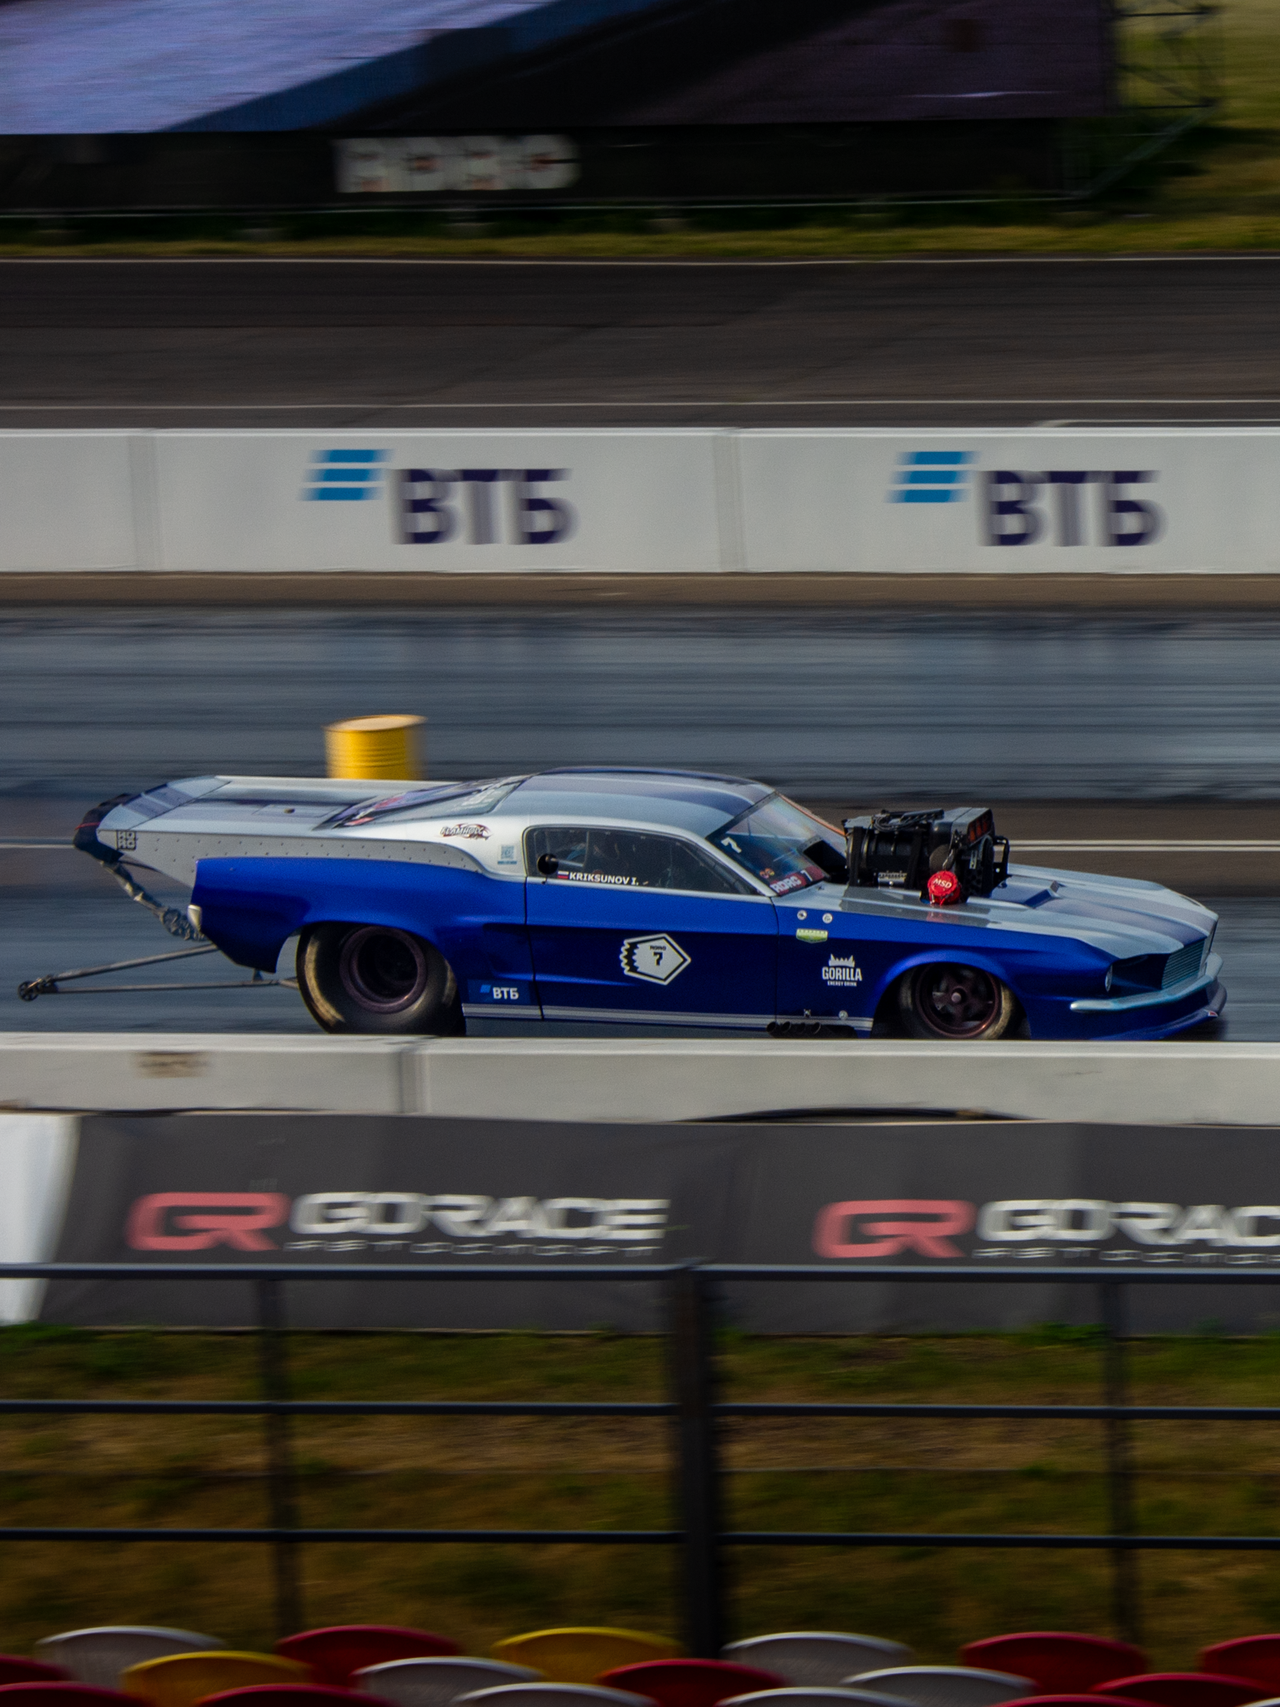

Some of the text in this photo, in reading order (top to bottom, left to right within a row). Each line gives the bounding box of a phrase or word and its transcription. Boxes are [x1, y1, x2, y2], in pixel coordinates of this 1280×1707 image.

[391, 468, 579, 545] ВТБ
[977, 470, 1167, 547] ВТБ
[720, 836, 742, 854] 7
[569, 871, 630, 885] KRIKSUNOV
[932, 878, 953, 888] MSD
[653, 952, 663, 966] 7
[822, 966, 863, 981] GORILLA
[492, 986, 520, 1000] ВТБ
